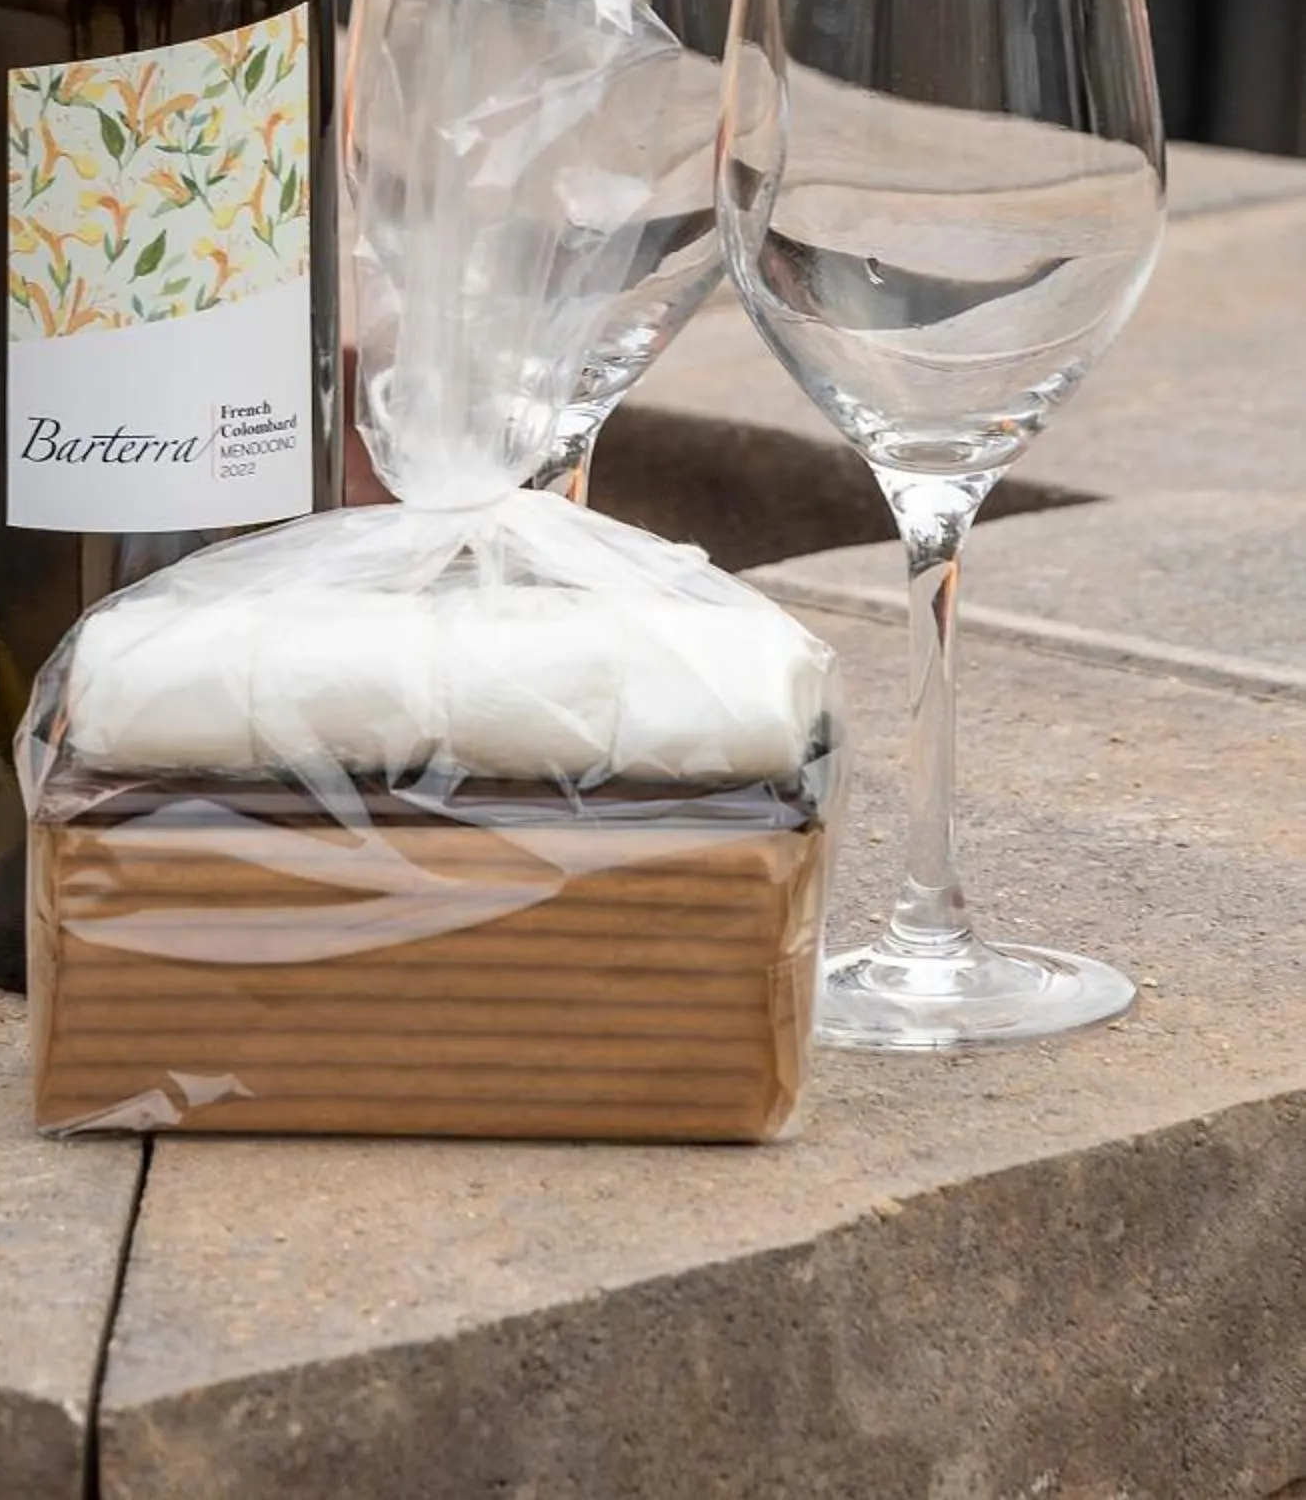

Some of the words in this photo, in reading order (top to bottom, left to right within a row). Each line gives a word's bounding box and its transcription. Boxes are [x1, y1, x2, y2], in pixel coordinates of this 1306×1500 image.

[220, 400, 272, 419] French
[220, 414, 298, 438] Colombard
[21, 416, 202, 464] Barterra
[220, 436, 297, 459] MENDOCINO
[220, 462, 256, 479] 2022
